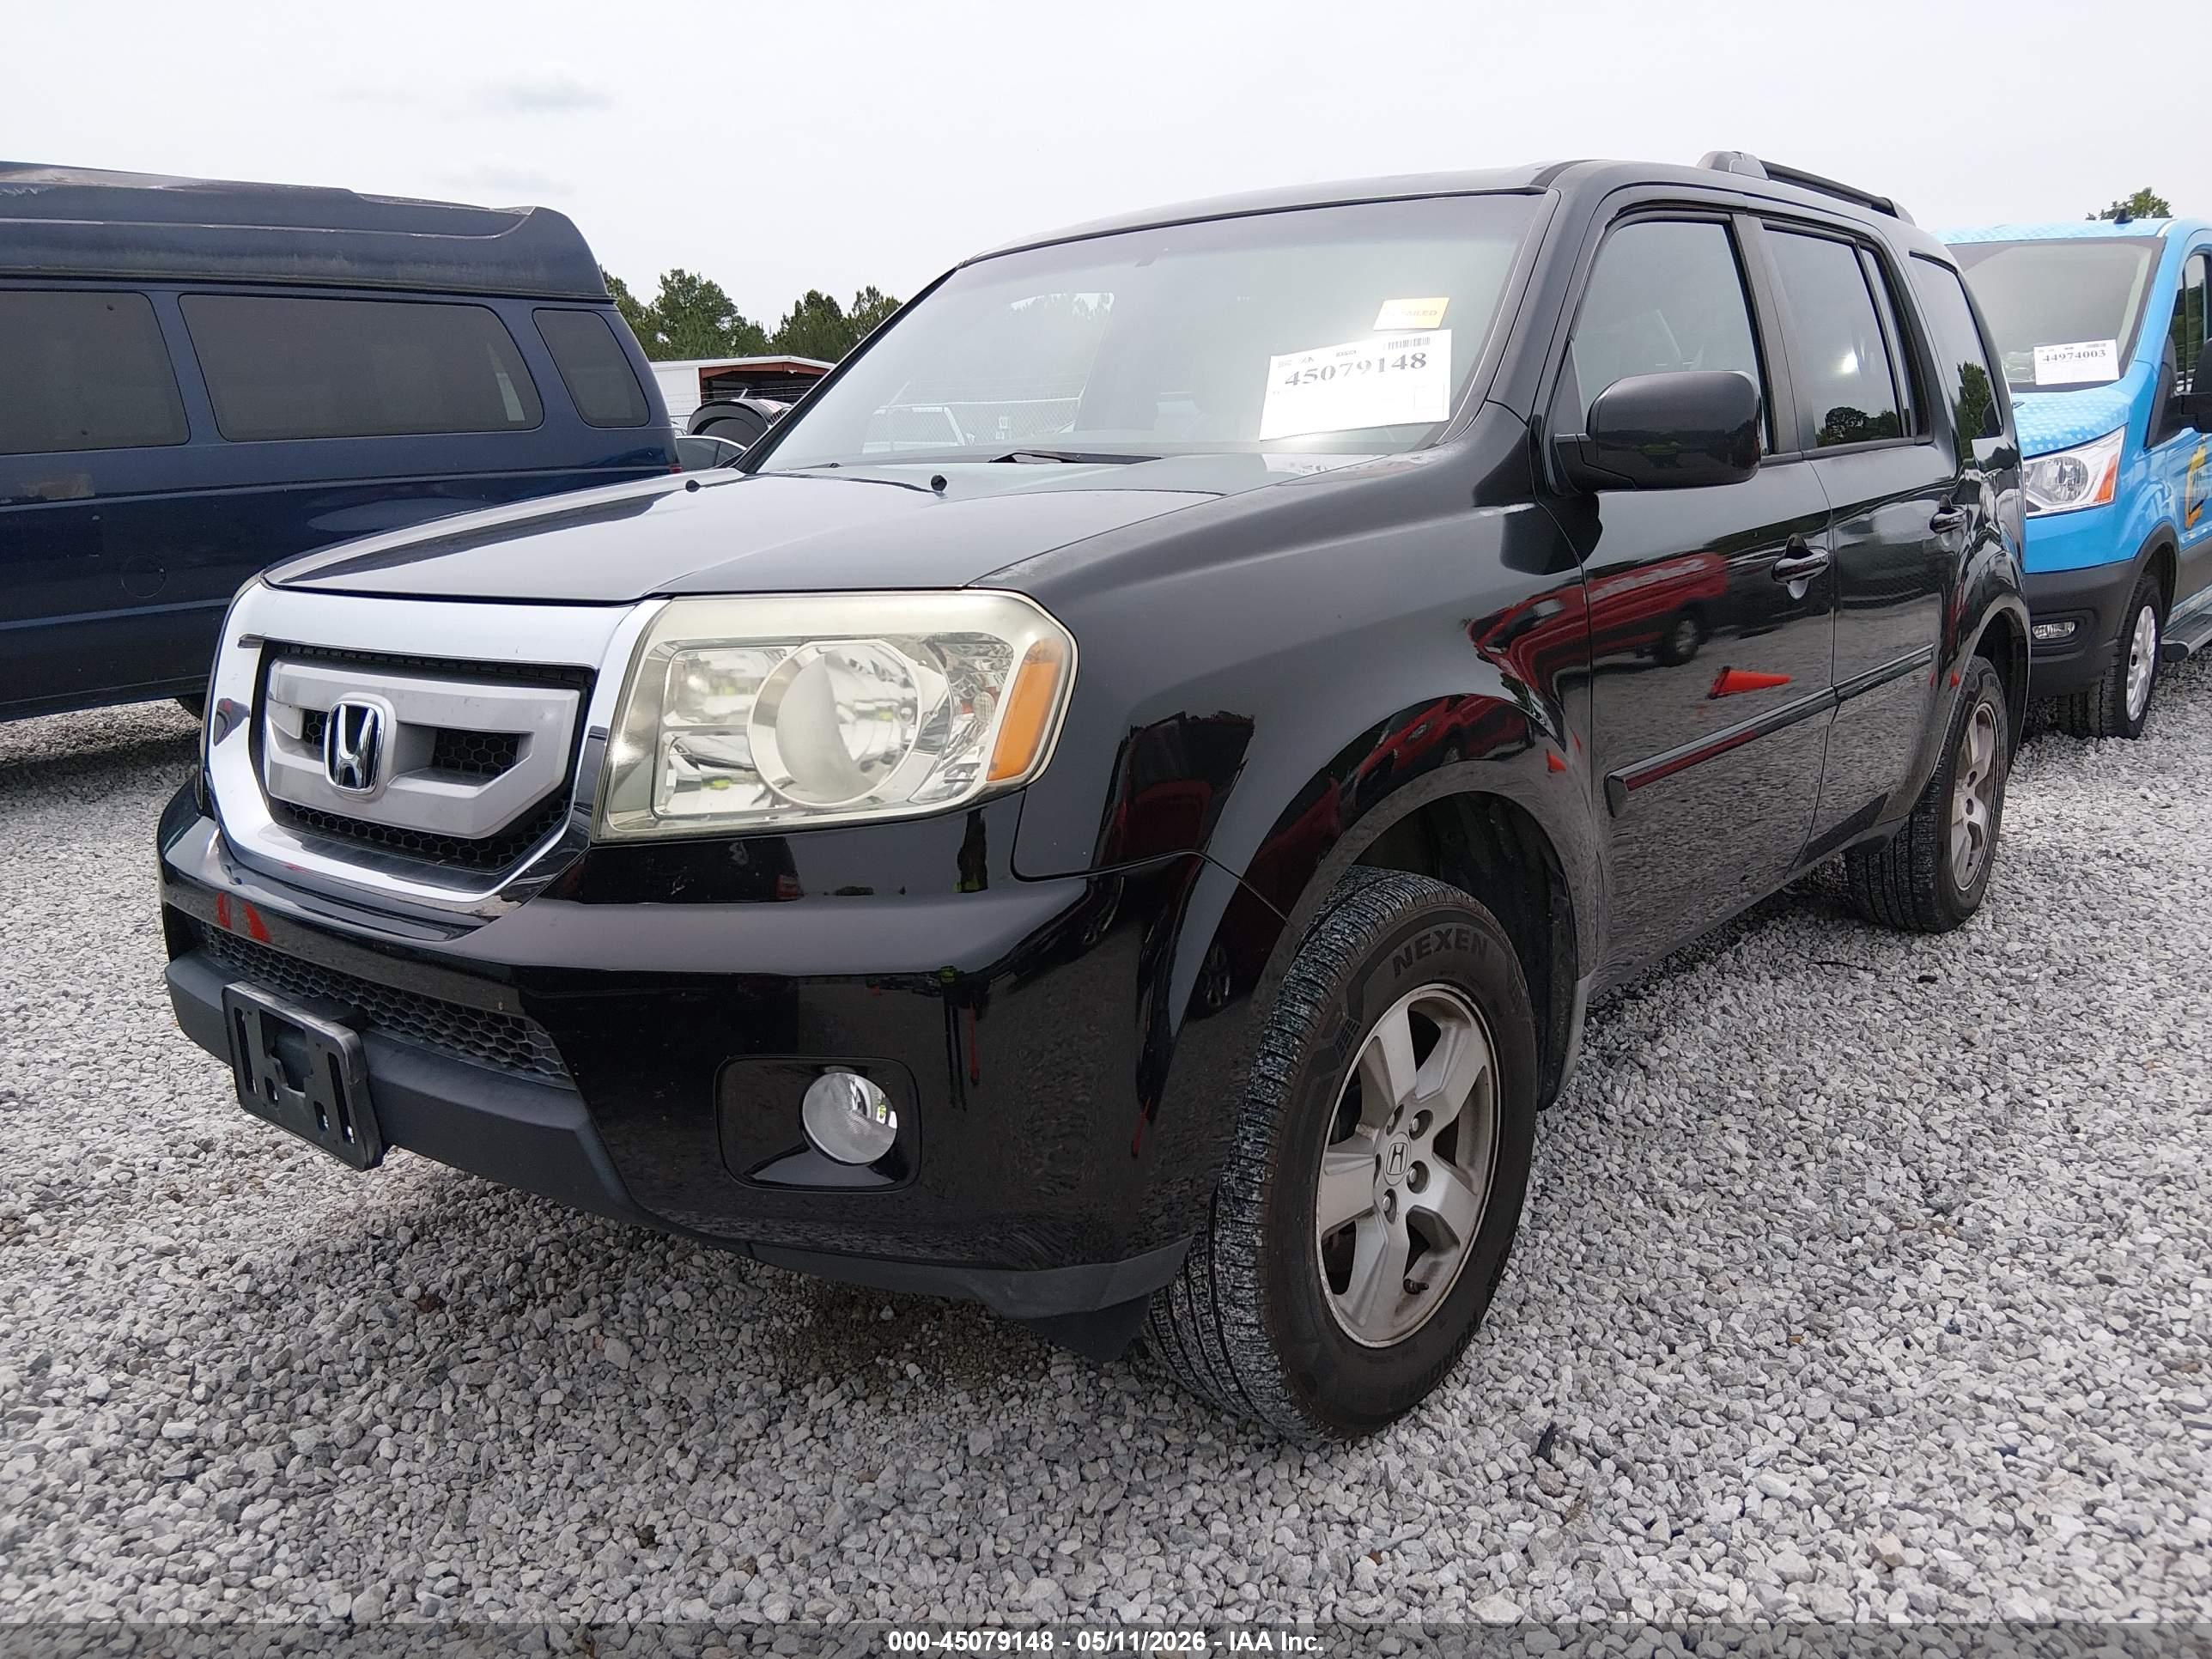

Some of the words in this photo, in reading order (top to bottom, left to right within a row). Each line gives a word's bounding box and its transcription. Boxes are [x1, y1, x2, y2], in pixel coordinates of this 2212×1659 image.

[1284, 351, 1427, 386] 45079148
[2042, 349, 2106, 362] 44974003
[1392, 927, 1490, 979] NEXEN
